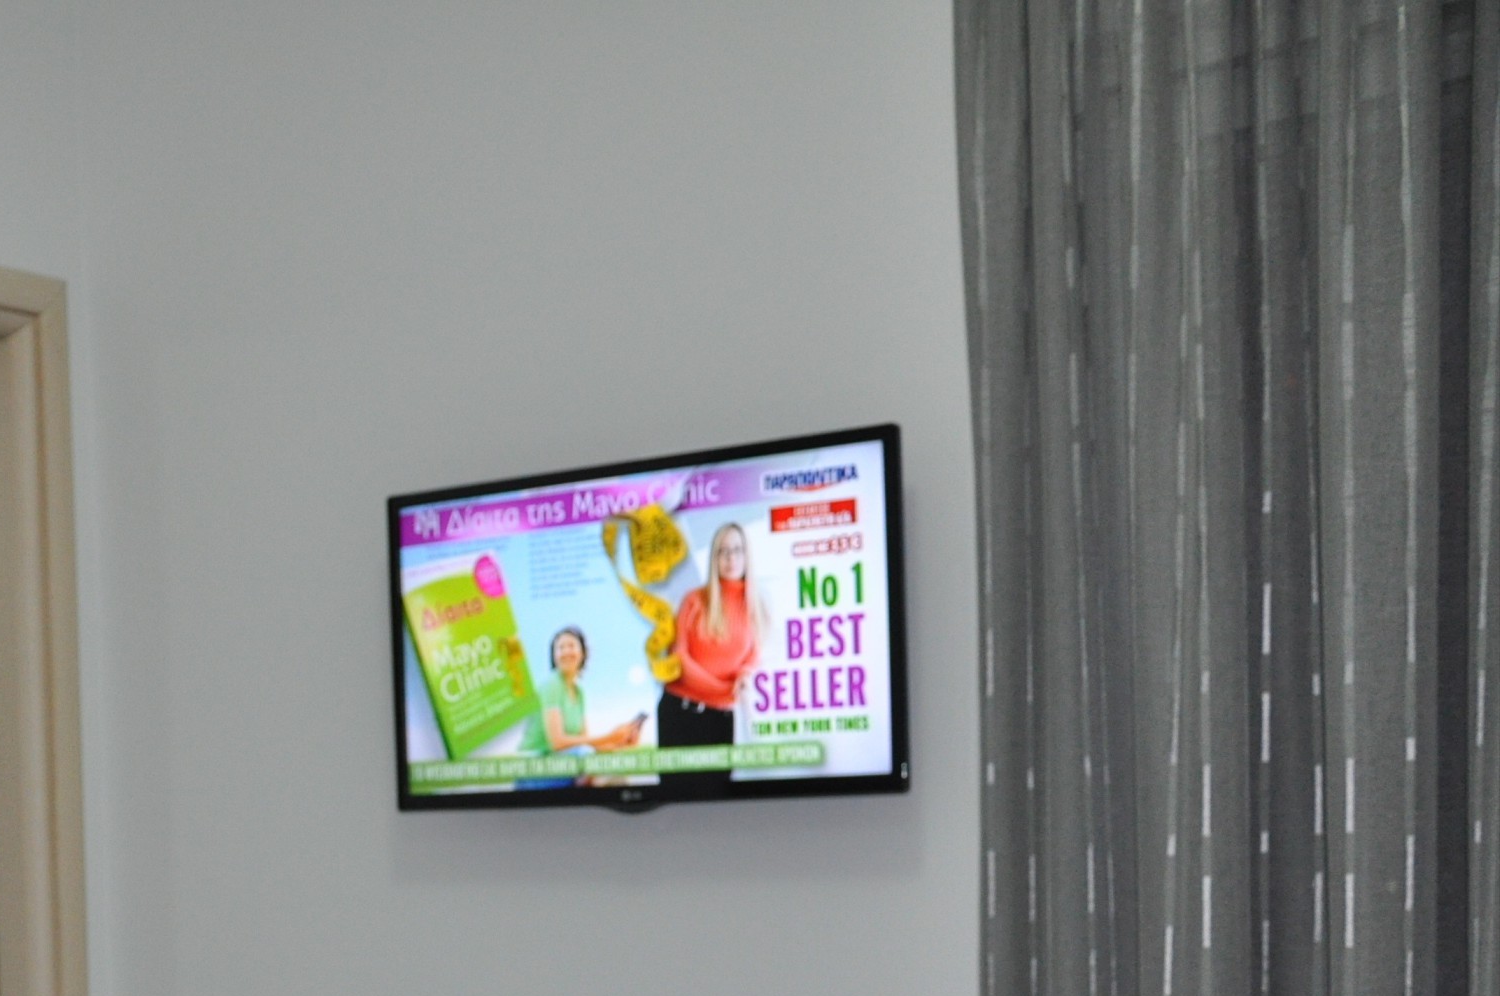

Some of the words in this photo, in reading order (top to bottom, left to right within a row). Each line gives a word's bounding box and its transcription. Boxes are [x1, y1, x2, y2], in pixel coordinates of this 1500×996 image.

[798, 567, 838, 609] No
[851, 561, 863, 604] 1
[432, 634, 493, 675] Mayo
[787, 614, 865, 660] BEST
[440, 659, 506, 703] Clinic
[754, 665, 867, 713] SELLER
